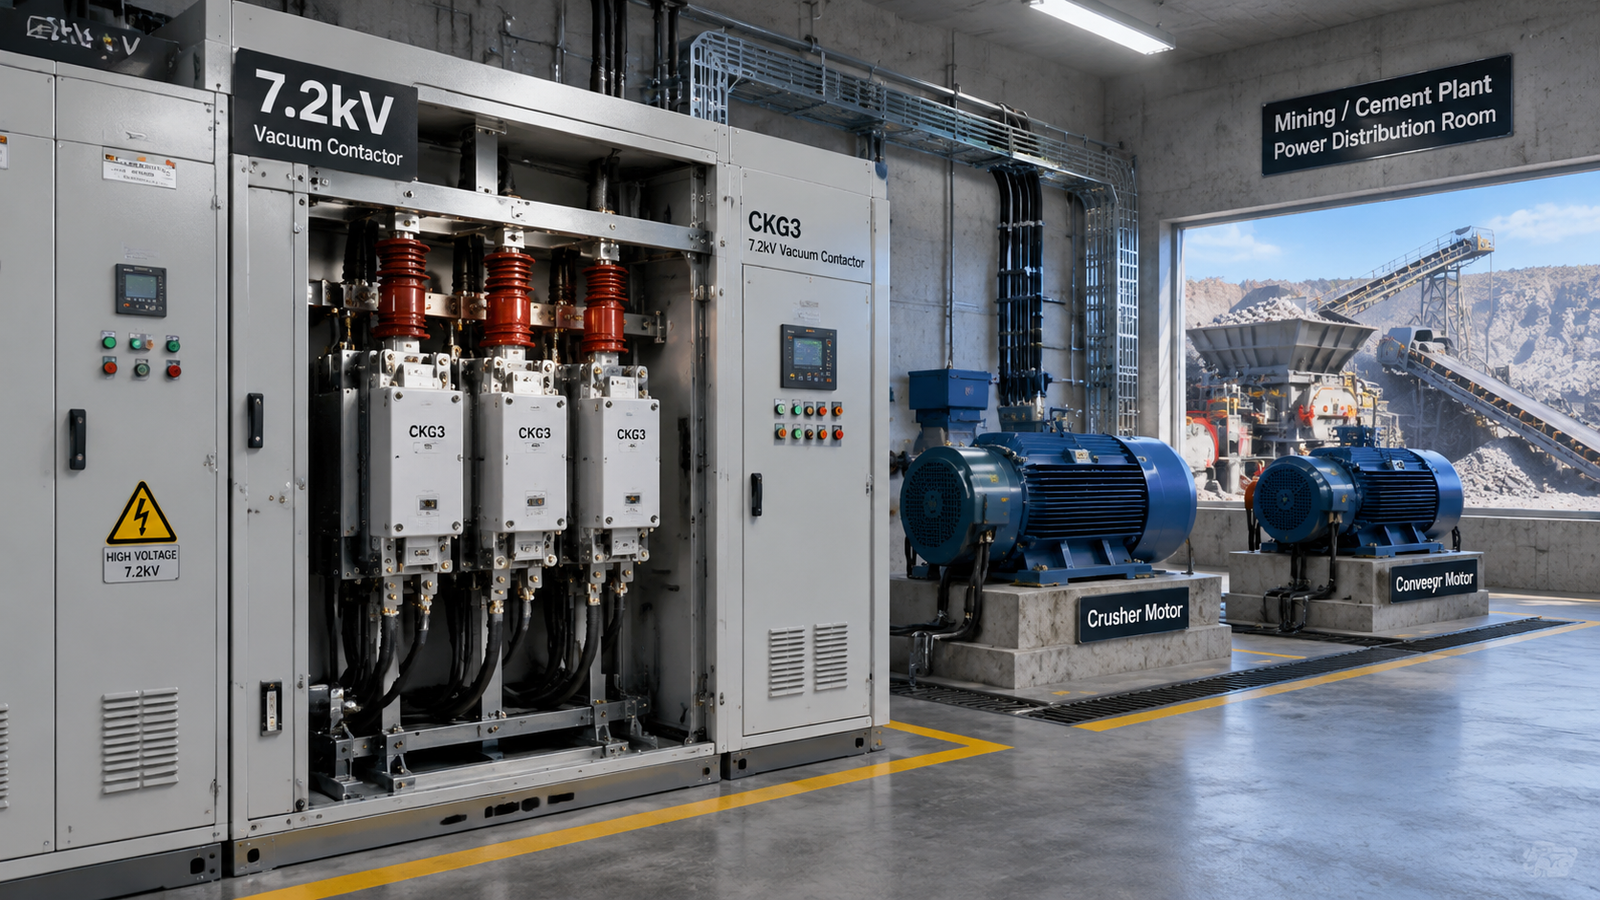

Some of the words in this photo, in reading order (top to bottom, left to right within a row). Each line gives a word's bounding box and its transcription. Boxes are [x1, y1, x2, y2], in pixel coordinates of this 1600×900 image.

[255, 68, 394, 136] 7.2kV
[1275, 108, 1336, 133] Mining
[1341, 100, 1349, 121] /
[1355, 86, 1432, 117] Cement
[1438, 75, 1492, 102] Plant
[253, 124, 322, 152] Vacuum
[327, 138, 403, 166] Contactor
[1274, 136, 1327, 160] Power
[1332, 119, 1435, 150] Distribution
[1441, 108, 1496, 131] Room
[748, 210, 801, 239] CKG3
[748, 238, 777, 254] 7.2kV
[779, 243, 818, 261] Vacuum
[821, 250, 865, 268] Contactor
[409, 425, 445, 438] CKG3
[518, 427, 551, 439] CKG3
[617, 429, 646, 440] CKG3
[106, 551, 131, 562] HIGH
[134, 550, 177, 561] VOLTAGE
[124, 565, 160, 578] 7.2KV
[1445, 571, 1474, 587] Motor
[1087, 606, 1142, 628] Crusher
[1145, 603, 1183, 621] Motor
